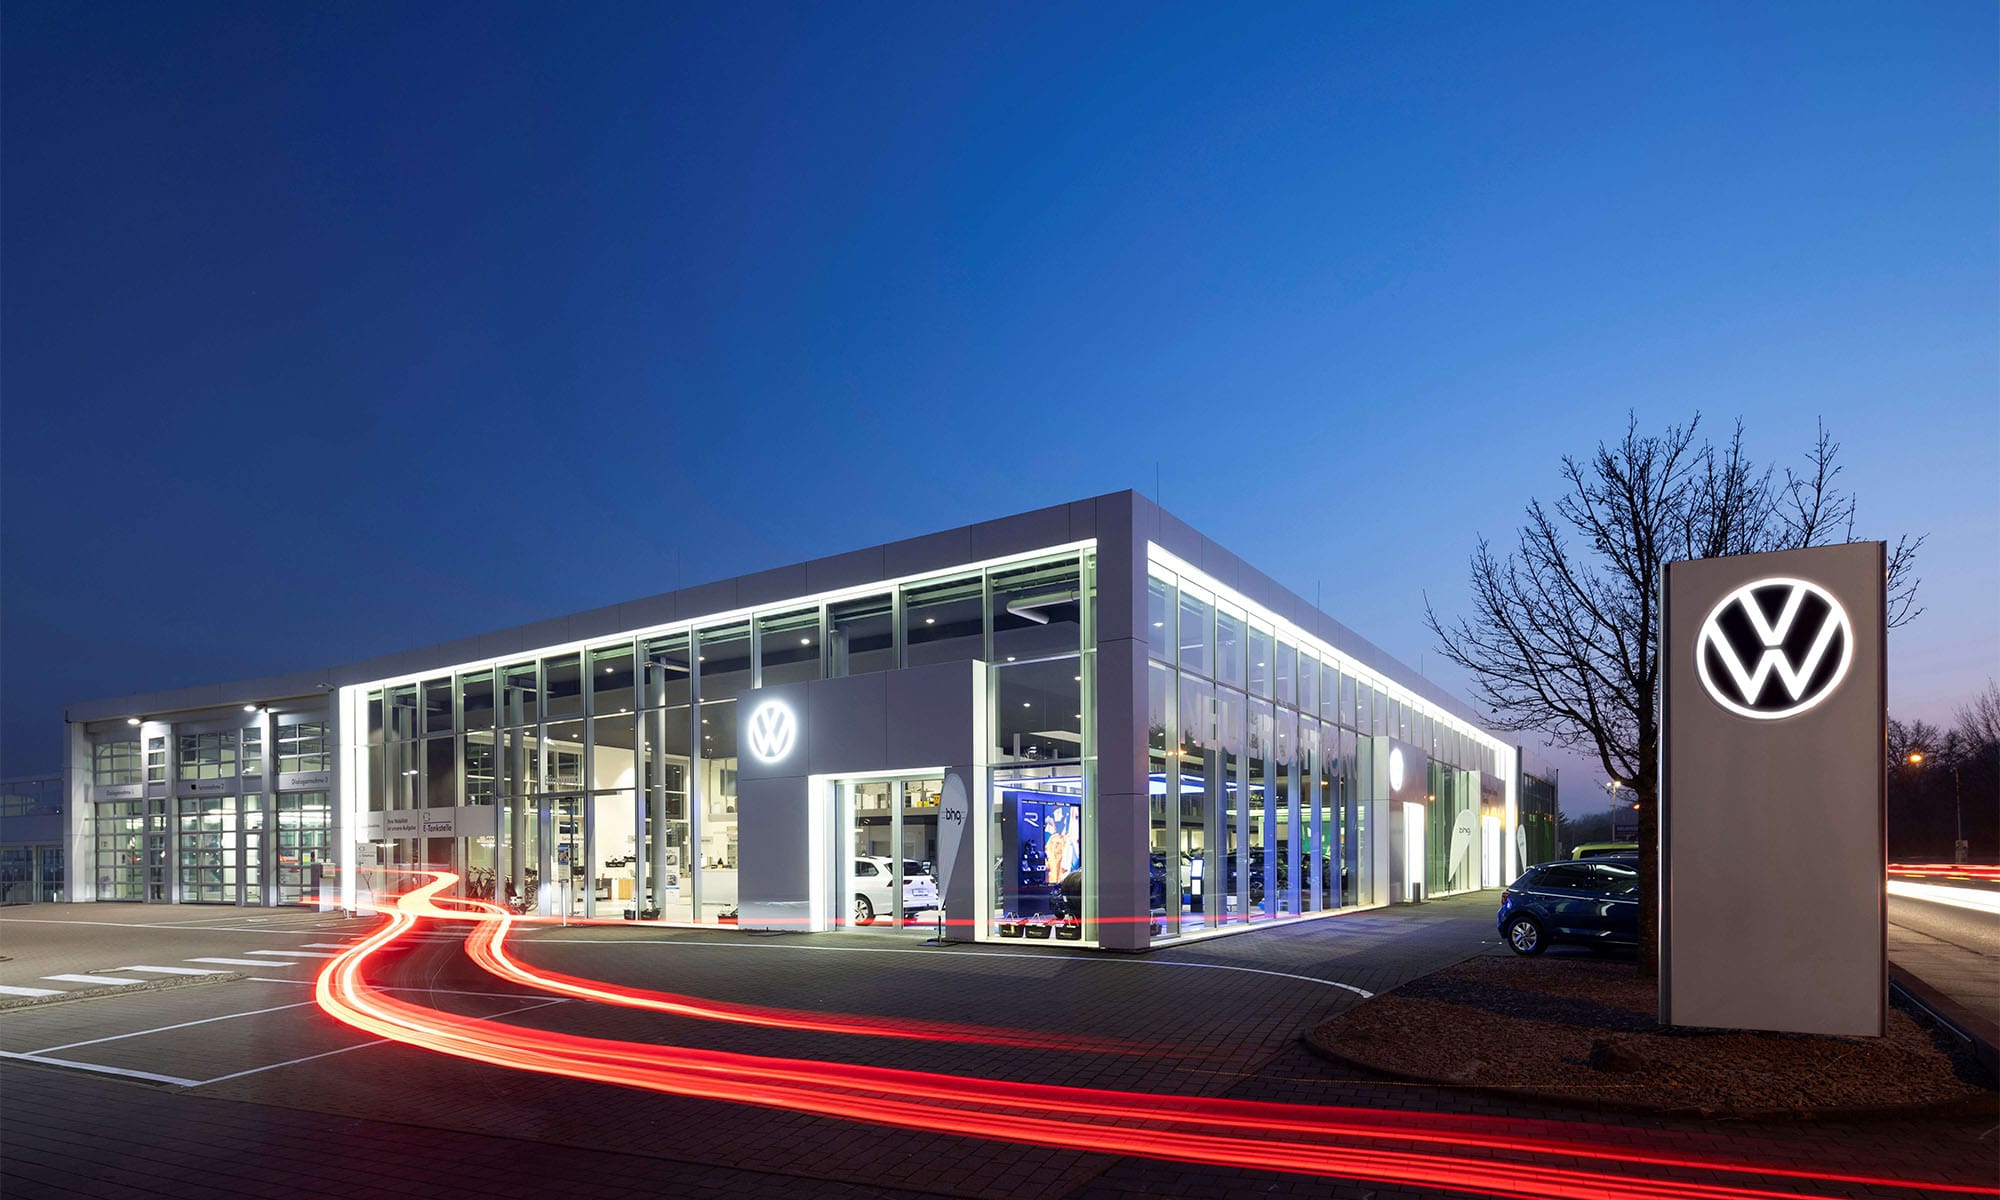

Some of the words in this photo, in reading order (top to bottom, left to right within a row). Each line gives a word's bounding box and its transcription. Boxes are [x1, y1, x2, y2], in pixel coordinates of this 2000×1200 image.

[1702, 580, 1847, 712] VW
[750, 702, 795, 761] VW
[423, 823, 452, 833] E-Tankstelle
[945, 808, 962, 826] bhg
